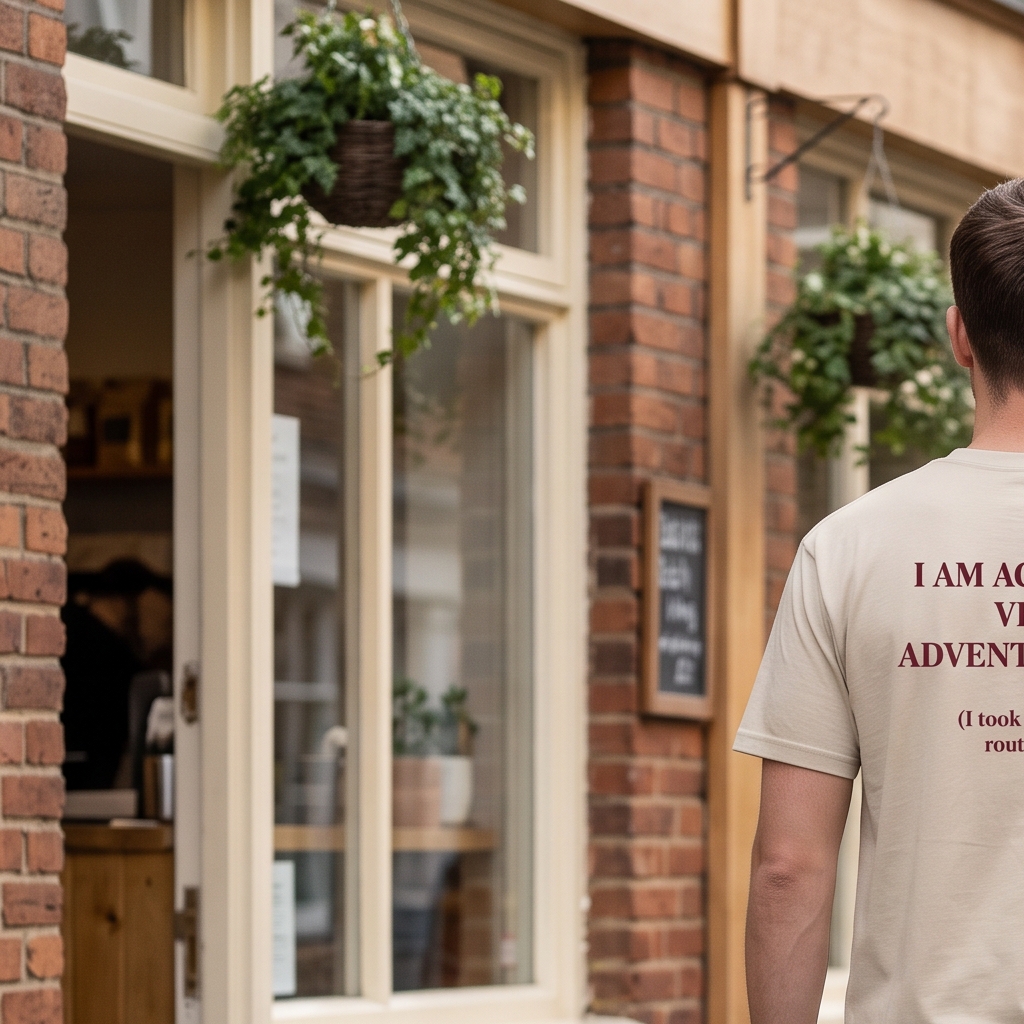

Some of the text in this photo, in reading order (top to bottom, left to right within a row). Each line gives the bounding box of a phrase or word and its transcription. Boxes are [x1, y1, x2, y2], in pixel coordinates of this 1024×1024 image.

[914, 562, 925, 588] I
[933, 562, 984, 588] AM
[957, 709, 973, 731] (I
[978, 709, 1022, 727] took
